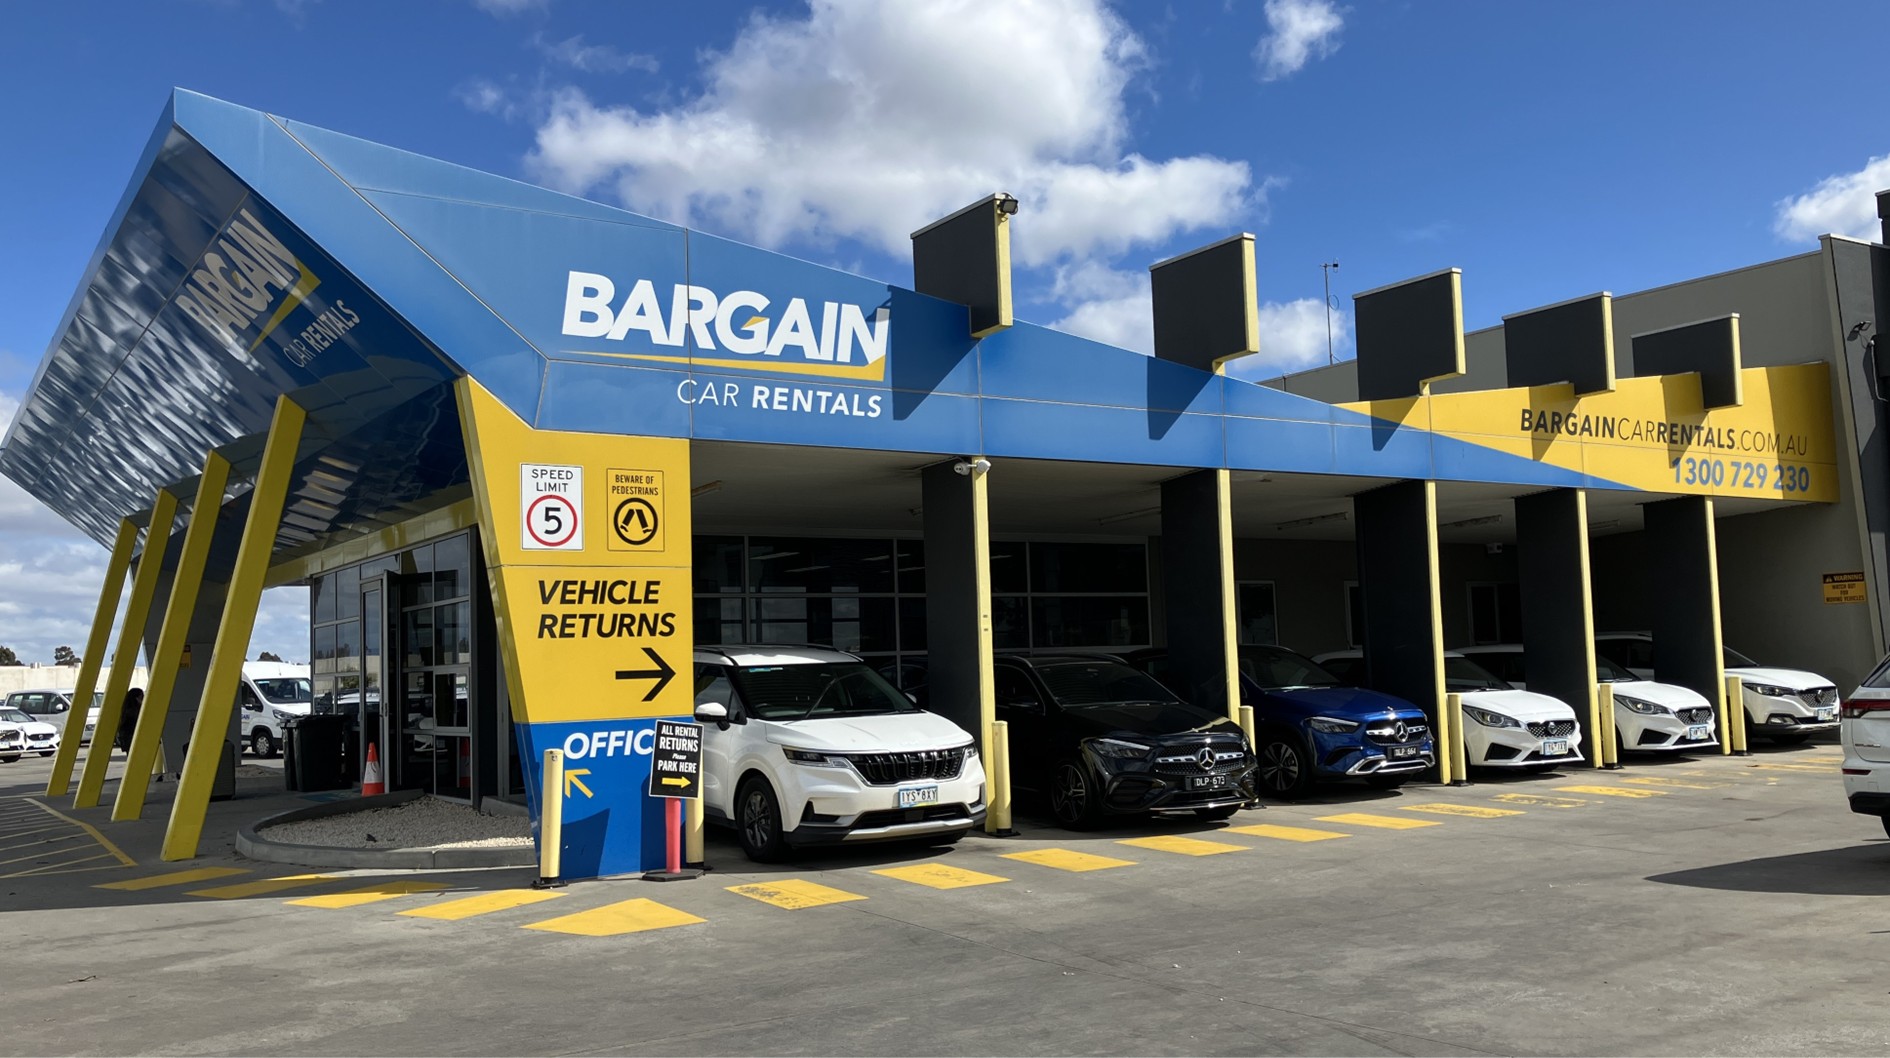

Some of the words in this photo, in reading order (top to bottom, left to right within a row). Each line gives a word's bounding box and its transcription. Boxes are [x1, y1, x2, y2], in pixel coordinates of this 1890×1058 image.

[175, 208, 302, 346] BARGAIN
[562, 271, 890, 365] BARGAIN
[283, 338, 316, 368] CAR
[301, 299, 360, 353] RENTALS
[677, 379, 739, 407] CAR
[752, 385, 882, 418] RENTALS
[1520, 408, 1808, 456] BARGAINCARRENTALS.COM.AU
[531, 469, 574, 480] SPEED
[536, 482, 568, 493] LIMIT
[615, 474, 643, 484] BEWARE
[646, 475, 655, 484] OF
[1671, 457, 1724, 487] 1300
[1730, 461, 1767, 489] 729
[1773, 464, 1810, 492] 230
[611, 485, 659, 496] PEDESTRIANS
[544, 507, 562, 535] 5
[538, 580, 661, 605] VEHICLE
[537, 612, 676, 638] RETURNS
[563, 728, 655, 760] OFFIC
[661, 724, 674, 736] ALL
[675, 726, 699, 738] RENTAL
[659, 736, 699, 753] RETURNS
[657, 760, 678, 772] PARK
[678, 762, 697, 773] HERE
